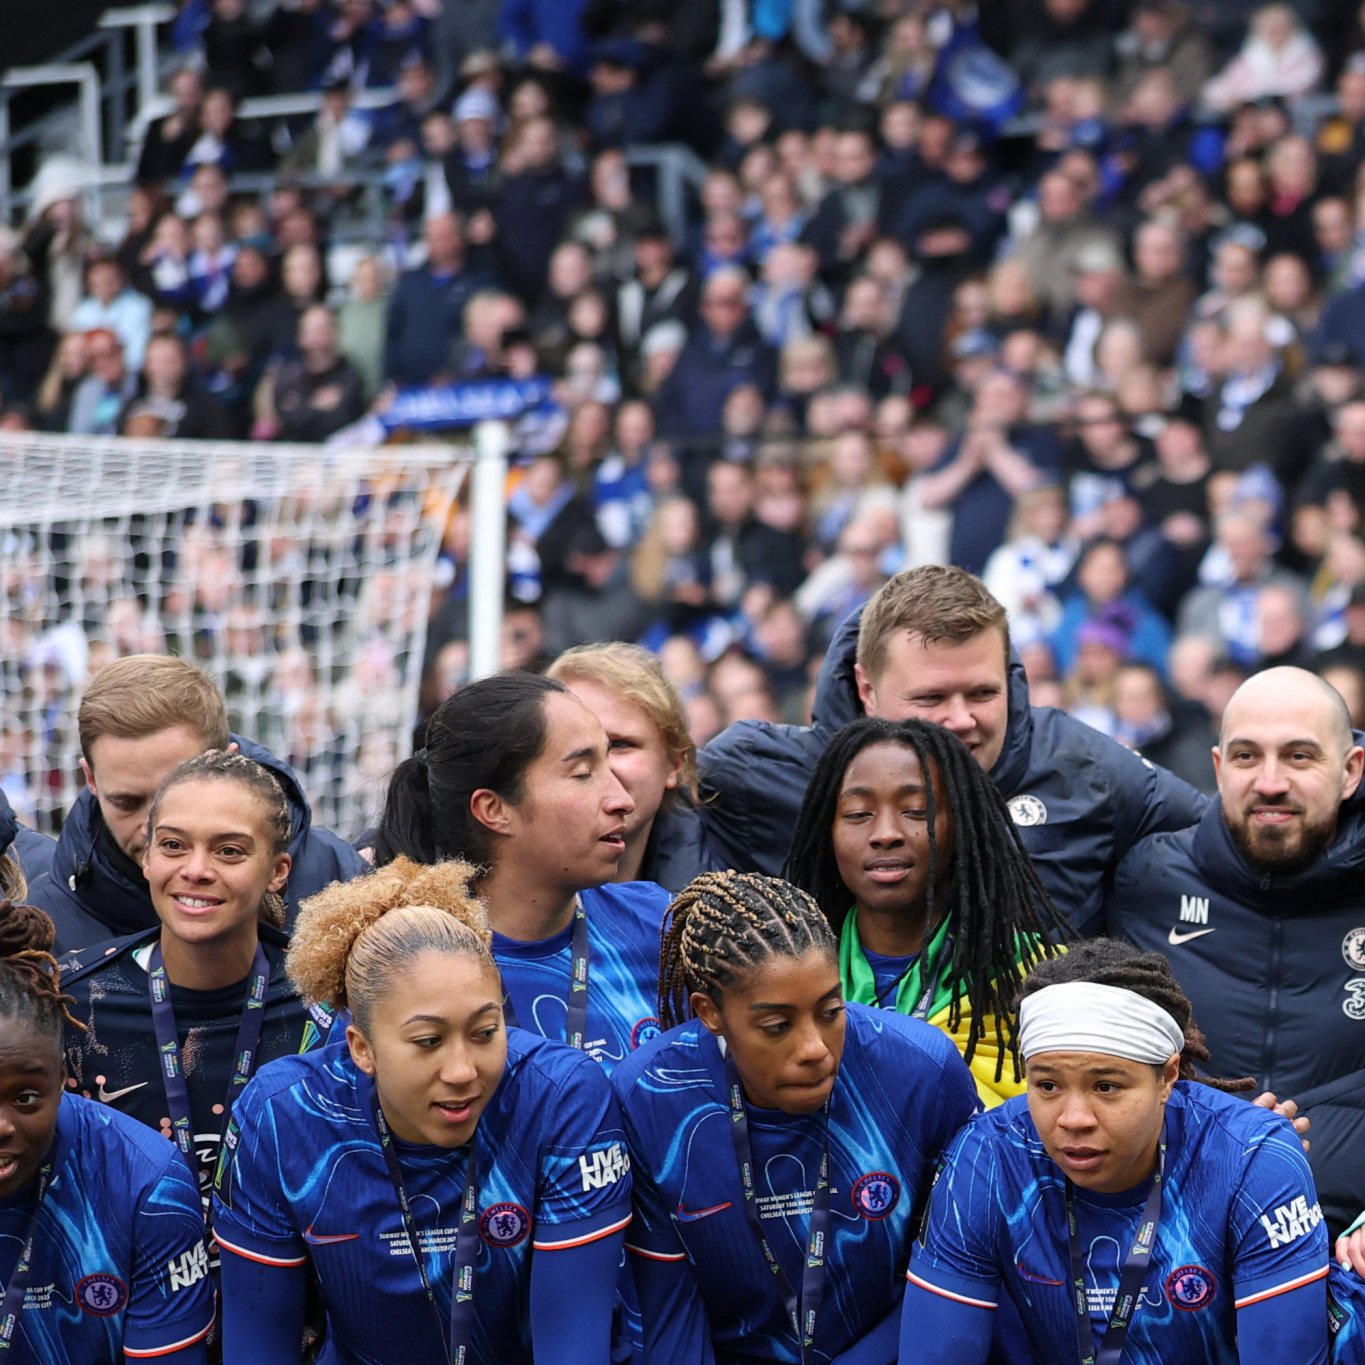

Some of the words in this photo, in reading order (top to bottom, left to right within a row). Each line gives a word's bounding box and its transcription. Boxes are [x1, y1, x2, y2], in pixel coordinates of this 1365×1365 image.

[1179, 894, 1209, 924] MN
[579, 1143, 623, 1174] LIVE
[859, 1175, 891, 1188] CHELSEA
[771, 1194, 793, 1203] WOMEN'S
[794, 1191, 813, 1199] LEAGUE
[486, 1202, 518, 1218] CHELSEA
[760, 1203, 785, 1212] SATURDAY
[1261, 1195, 1309, 1230] LIVE
[167, 1239, 209, 1275] LIVE
[1172, 1267, 1203, 1281] CHELSEA
